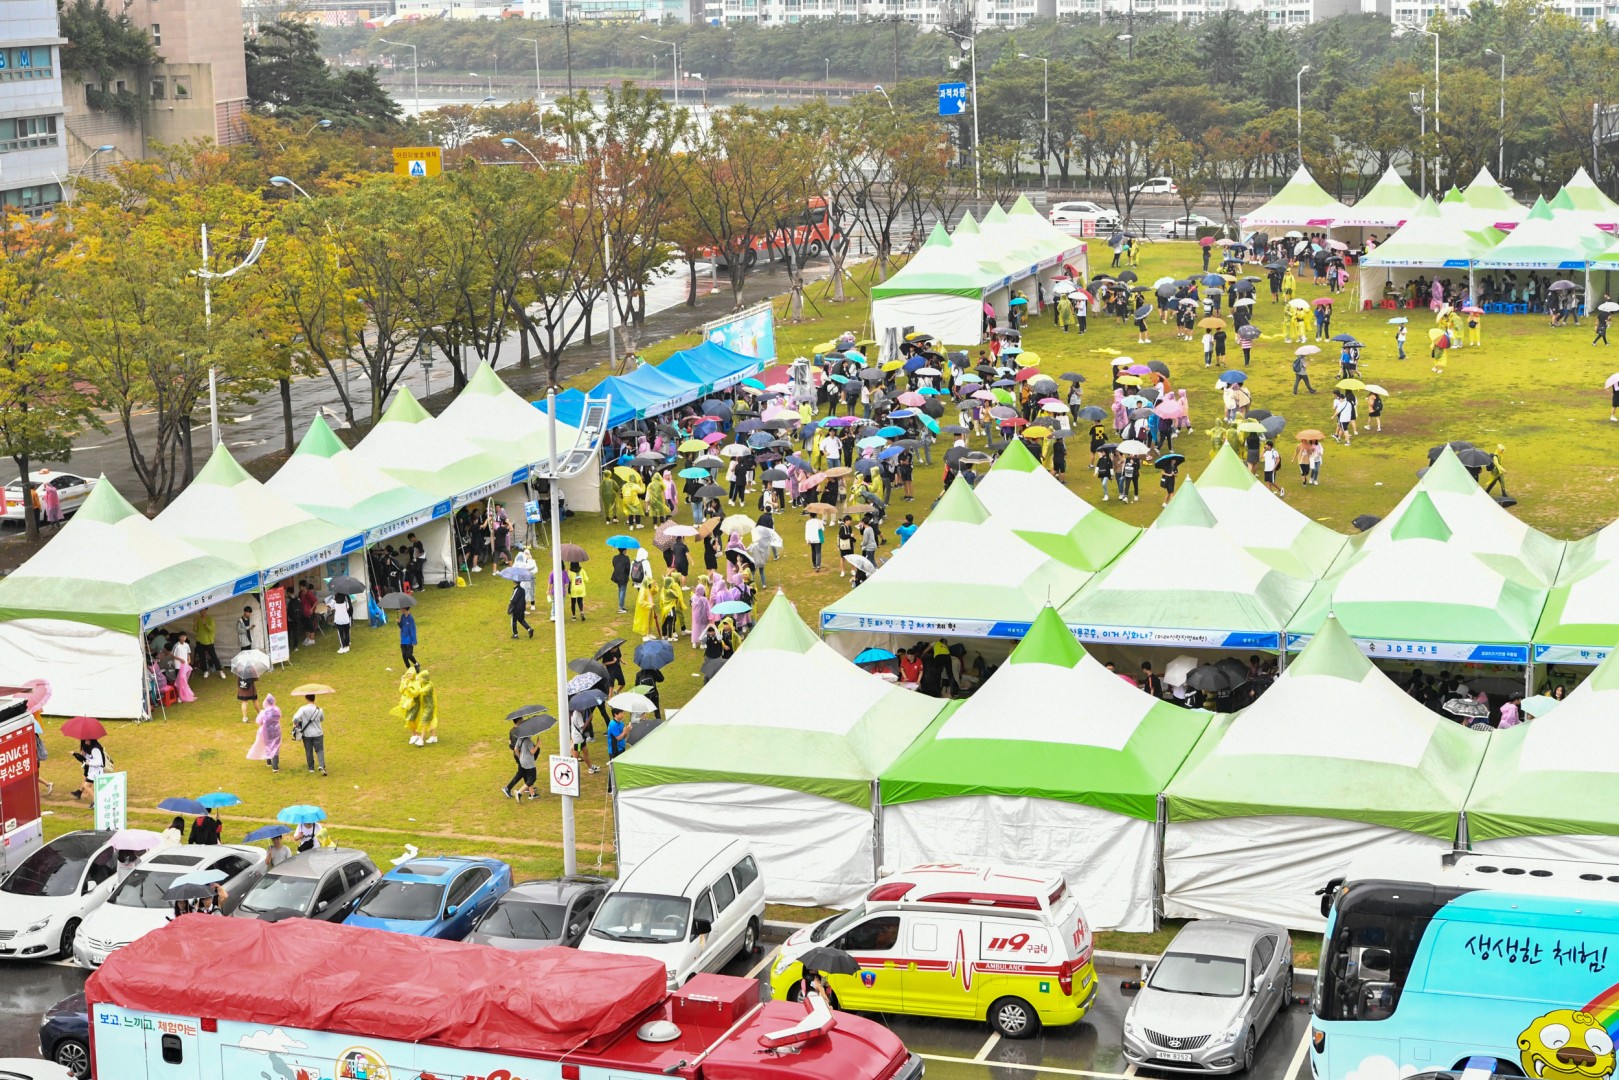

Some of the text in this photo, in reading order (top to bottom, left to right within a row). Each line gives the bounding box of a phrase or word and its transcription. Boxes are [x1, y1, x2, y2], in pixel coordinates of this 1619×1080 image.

[939, 87, 966, 98] 과적차량
[1102, 630, 1120, 638] 이거
[0, 757, 31, 781] 부산은행
[987, 933, 1048, 954] 119 구급대
[1464, 934, 1608, 973] 생생한 체험!
[985, 962, 1026, 971] AMBULANCE
[100, 1013, 197, 1036] 보고, 느끼고, 체험하는
